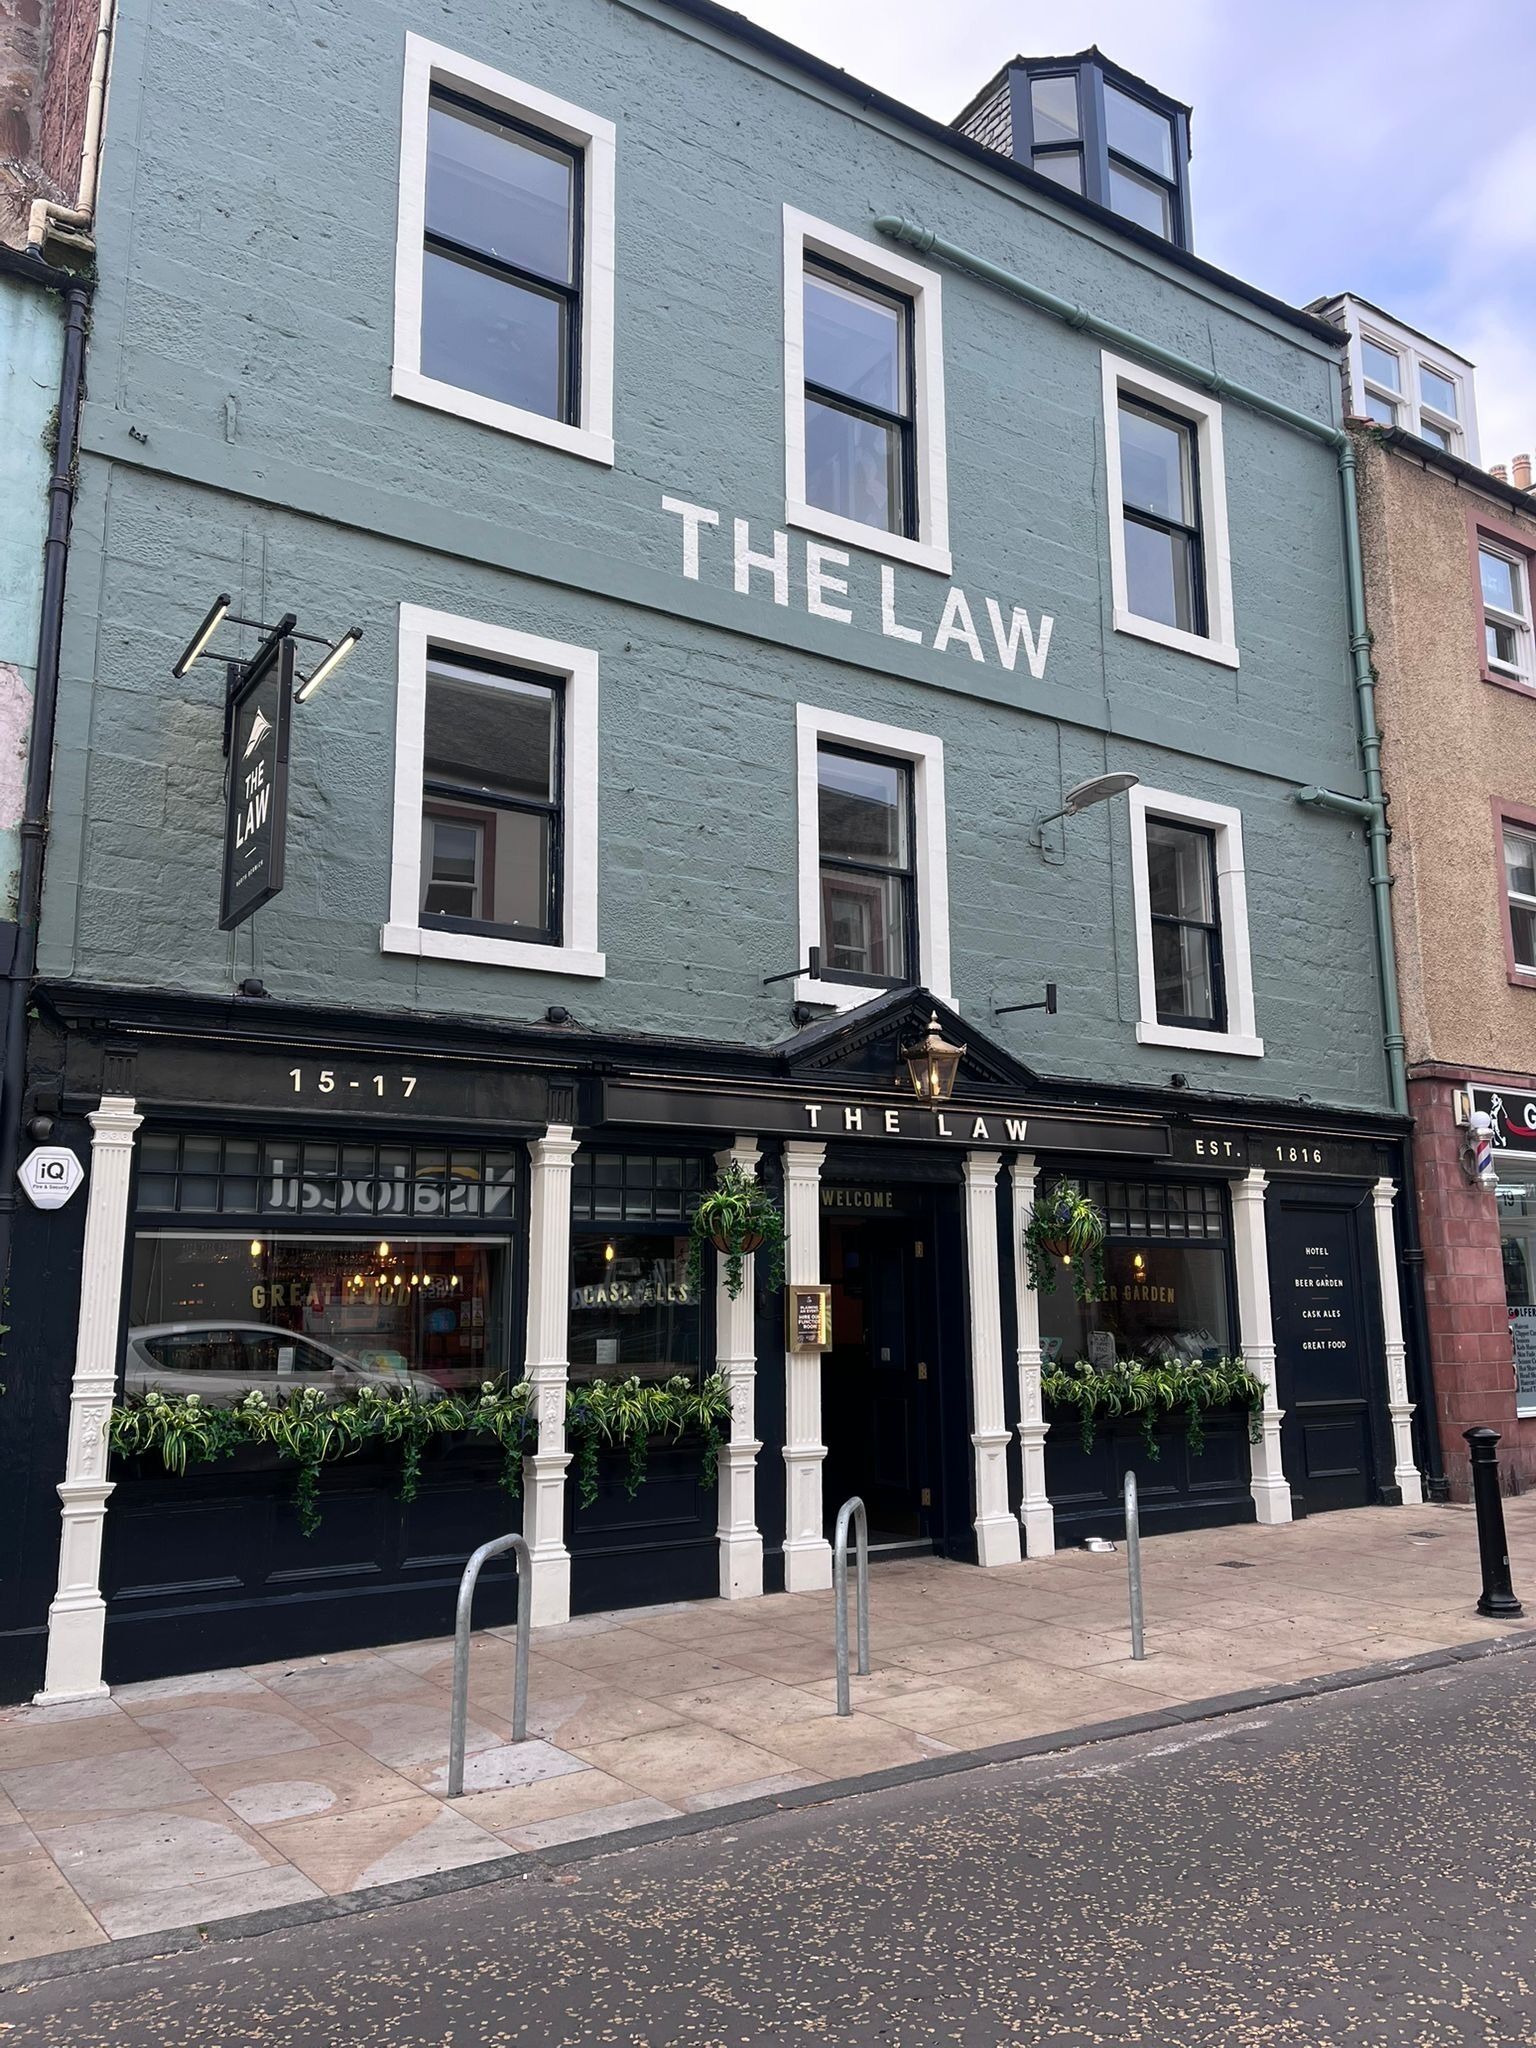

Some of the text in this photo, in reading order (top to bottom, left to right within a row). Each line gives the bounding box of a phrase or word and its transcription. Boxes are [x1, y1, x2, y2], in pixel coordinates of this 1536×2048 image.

[661, 494, 1055, 679] THE LAW
[245, 760, 265, 799] THE
[235, 783, 271, 849] LAW
[289, 1068, 417, 1098] 15-17
[805, 1104, 1028, 1142] THE LAW
[1195, 1139, 1322, 1163] EST. 1816
[41, 1162, 64, 1180] iQ
[822, 1189, 894, 1209] WELCOME
[1502, 1191, 1515, 1207] 19
[1305, 1247, 1329, 1256] HOTEL
[1294, 1279, 1344, 1288] BEER GARDEN
[251, 1282, 335, 1310] GREAT
[1124, 1285, 1175, 1304] GARDEN
[1302, 1309, 1341, 1319] CASK ALES
[1302, 1340, 1347, 1350] GREAT FOOD
